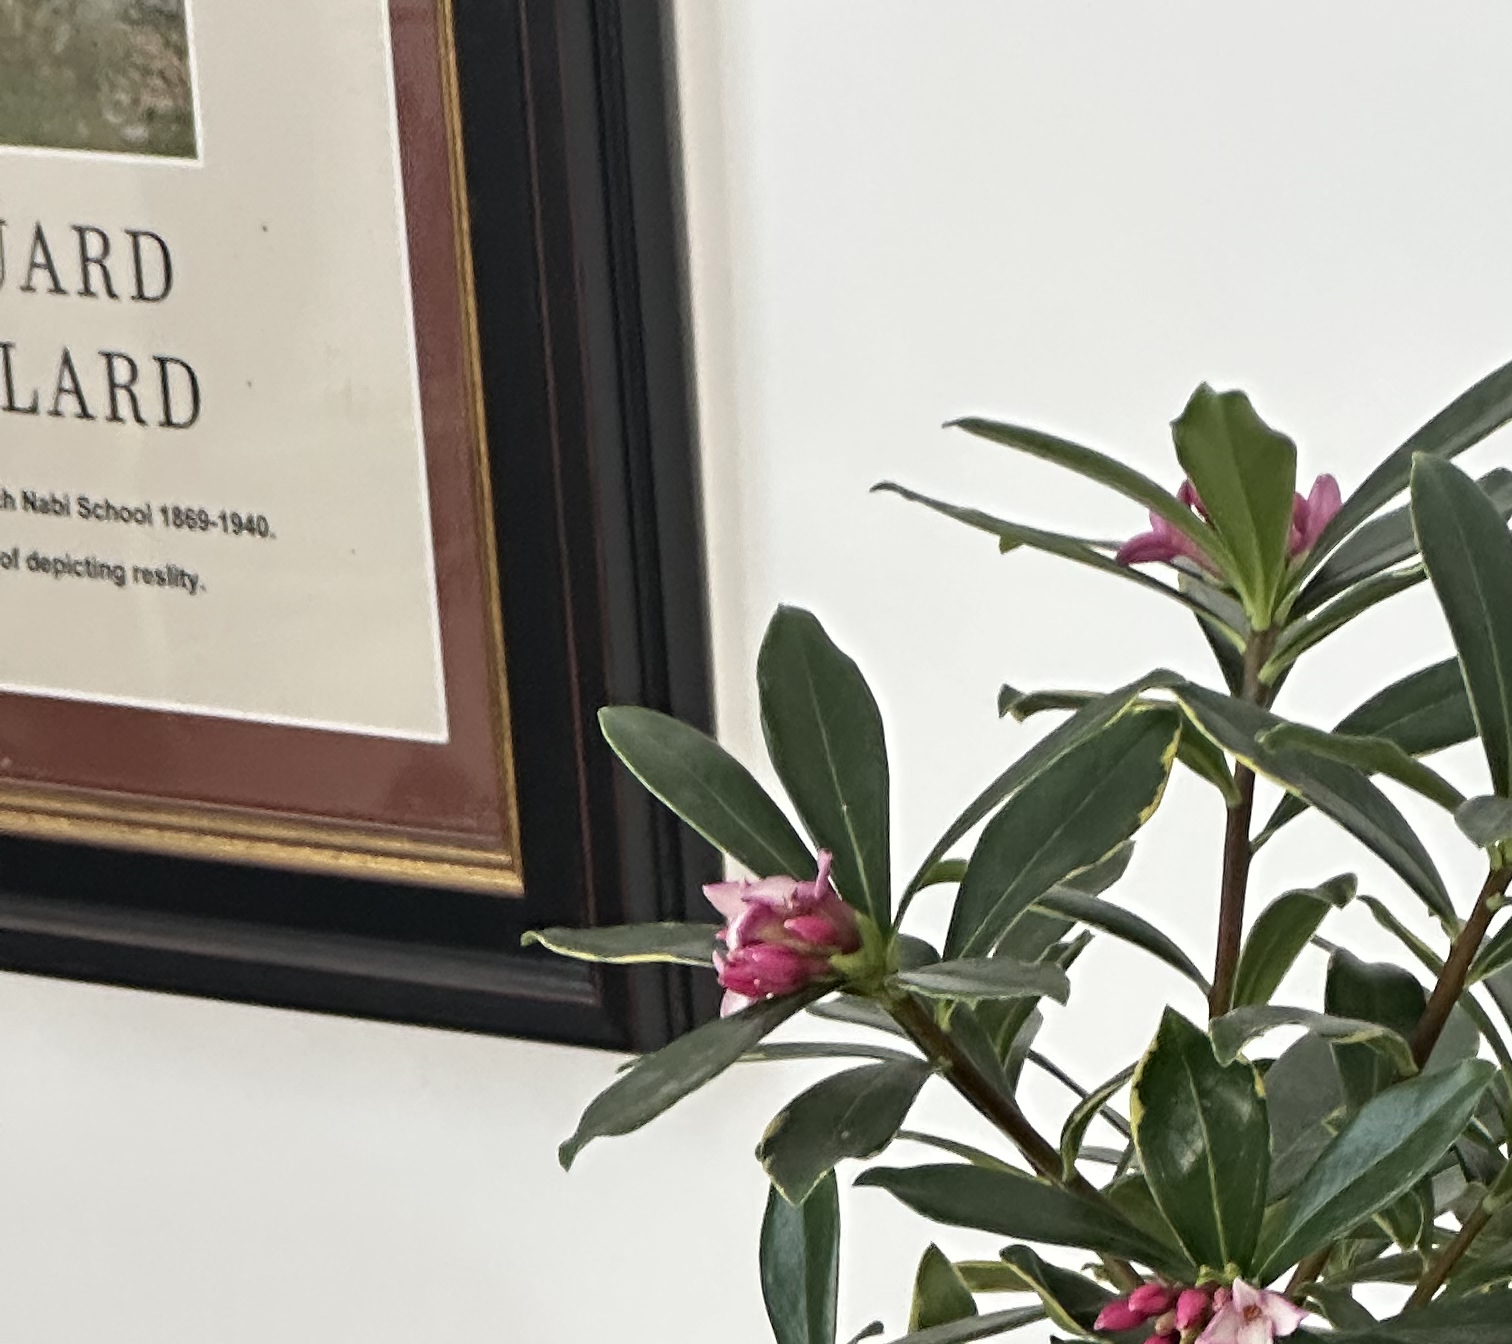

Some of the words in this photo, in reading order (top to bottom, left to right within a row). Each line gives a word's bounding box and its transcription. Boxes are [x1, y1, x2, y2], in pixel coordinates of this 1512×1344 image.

[21, 490, 71, 517] Nabi
[76, 494, 153, 526] School
[26, 551, 126, 588] depicting
